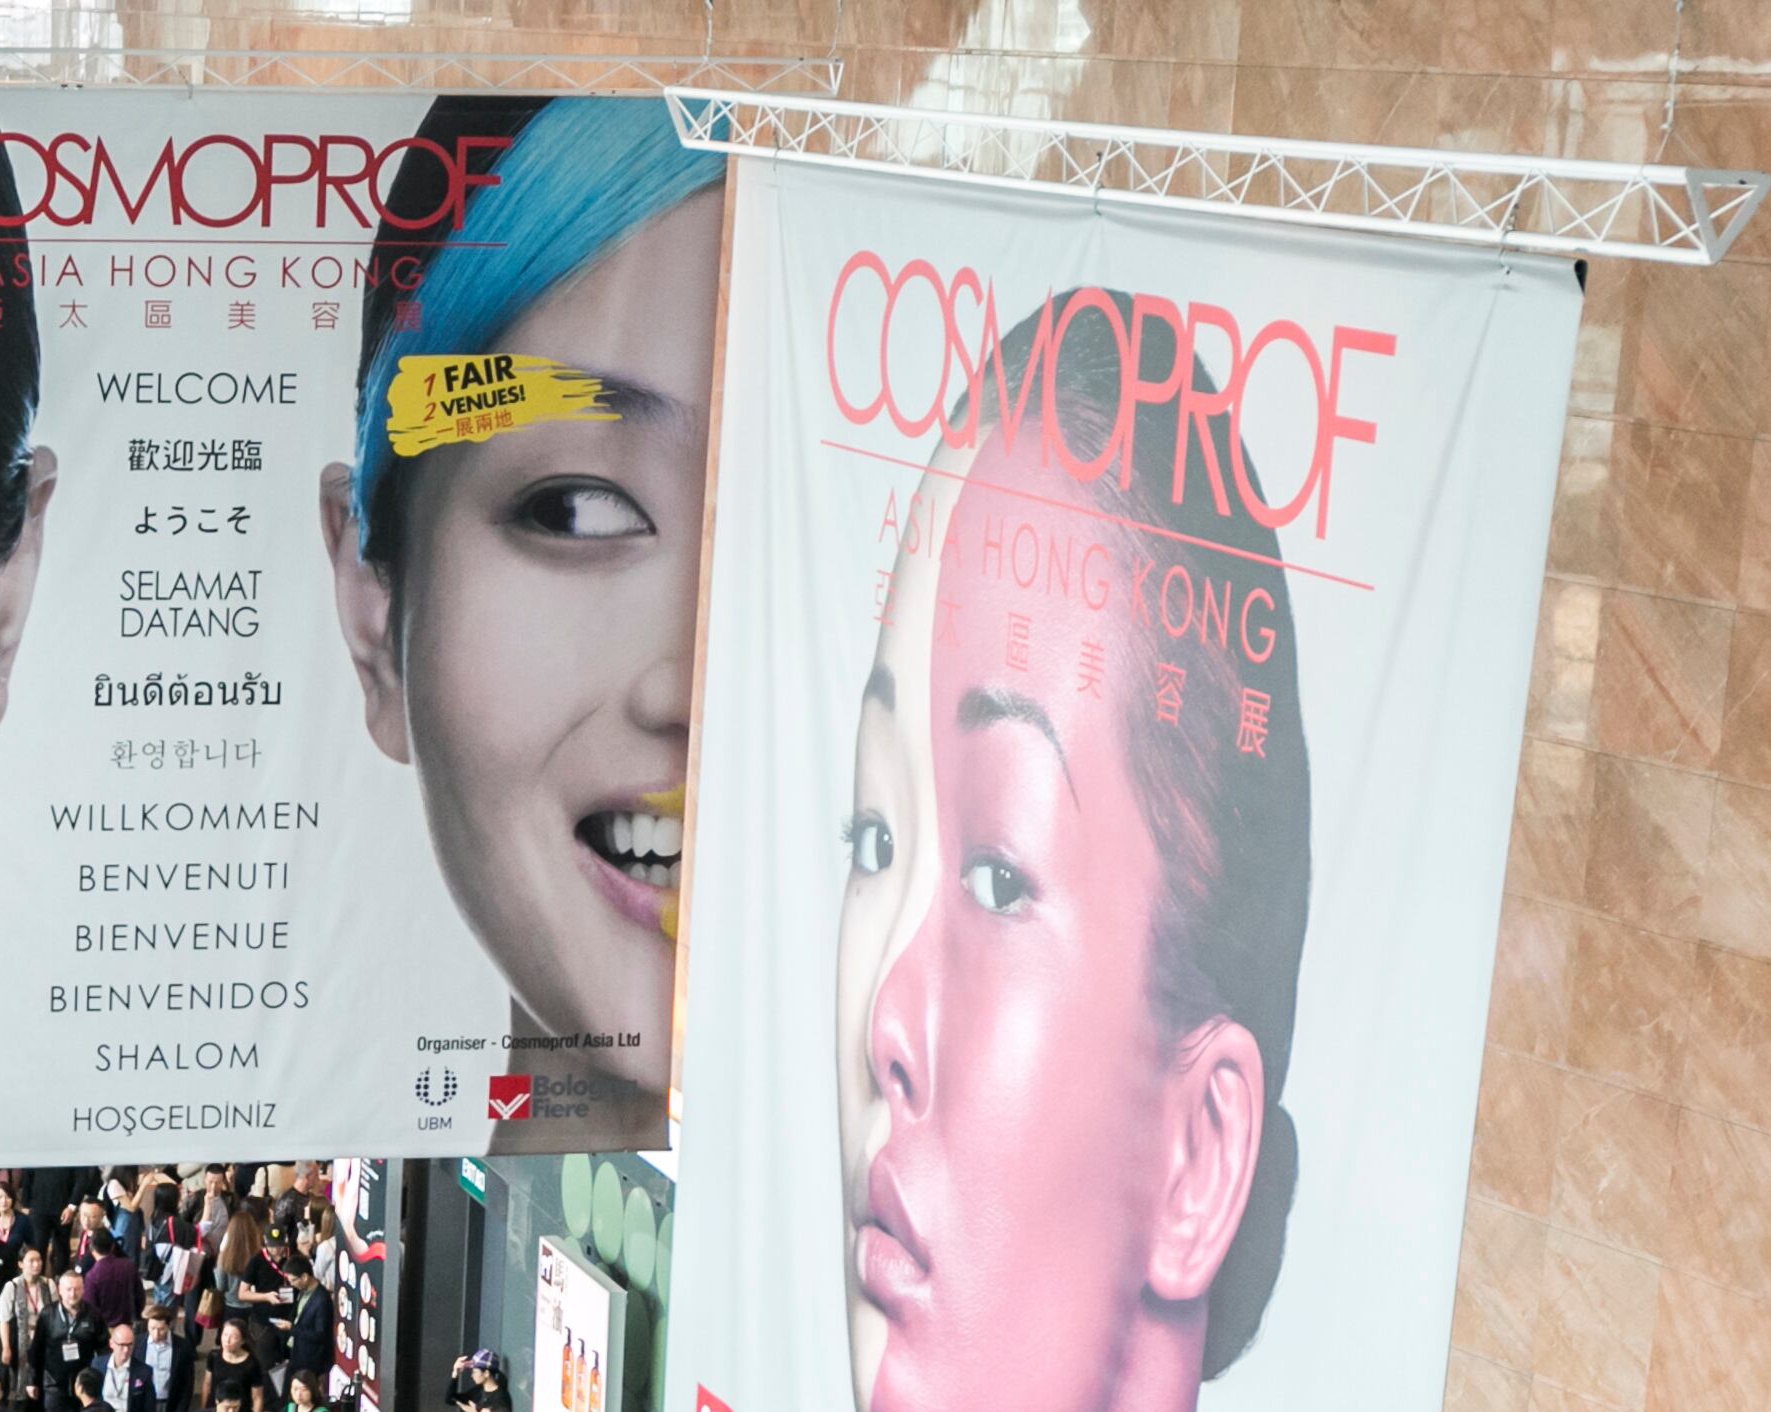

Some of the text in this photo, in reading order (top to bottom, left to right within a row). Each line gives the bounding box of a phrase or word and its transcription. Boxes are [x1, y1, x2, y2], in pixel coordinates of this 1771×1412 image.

[110, 253, 258, 289] HONG
[280, 255, 423, 291] KONG
[97, 372, 297, 404] WELCOME
[424, 355, 516, 397] 1 FAIR
[423, 385, 526, 422] 2 VENUES!
[827, 250, 1397, 540] COSMOPROF
[436, 409, 514, 437] 一展兩地
[128, 439, 263, 472] 歡迎光臨
[134, 506, 251, 535] ようこそ
[120, 570, 263, 601] SELAMAT
[878, 486, 1276, 664] ASIA HONG KONG
[120, 607, 260, 637] DATANG
[94, 671, 281, 706] ยินดีต้อนรับ
[110, 738, 263, 770] 환영합니다
[50, 802, 319, 831] WILLKOMMEN
[79, 862, 288, 892] BENVENUTI
[76, 921, 289, 952] BIENVENUE
[50, 981, 309, 1013] BIENVENIDOS
[95, 1042, 259, 1072] SHALOM
[417, 1032, 640, 1054] Organiser Cosmoprof Asia Ltd
[73, 1100, 277, 1137] HOŞGELDİNİZ
[417, 1117, 453, 1131] UBM
[533, 1099, 589, 1118] Fiere
